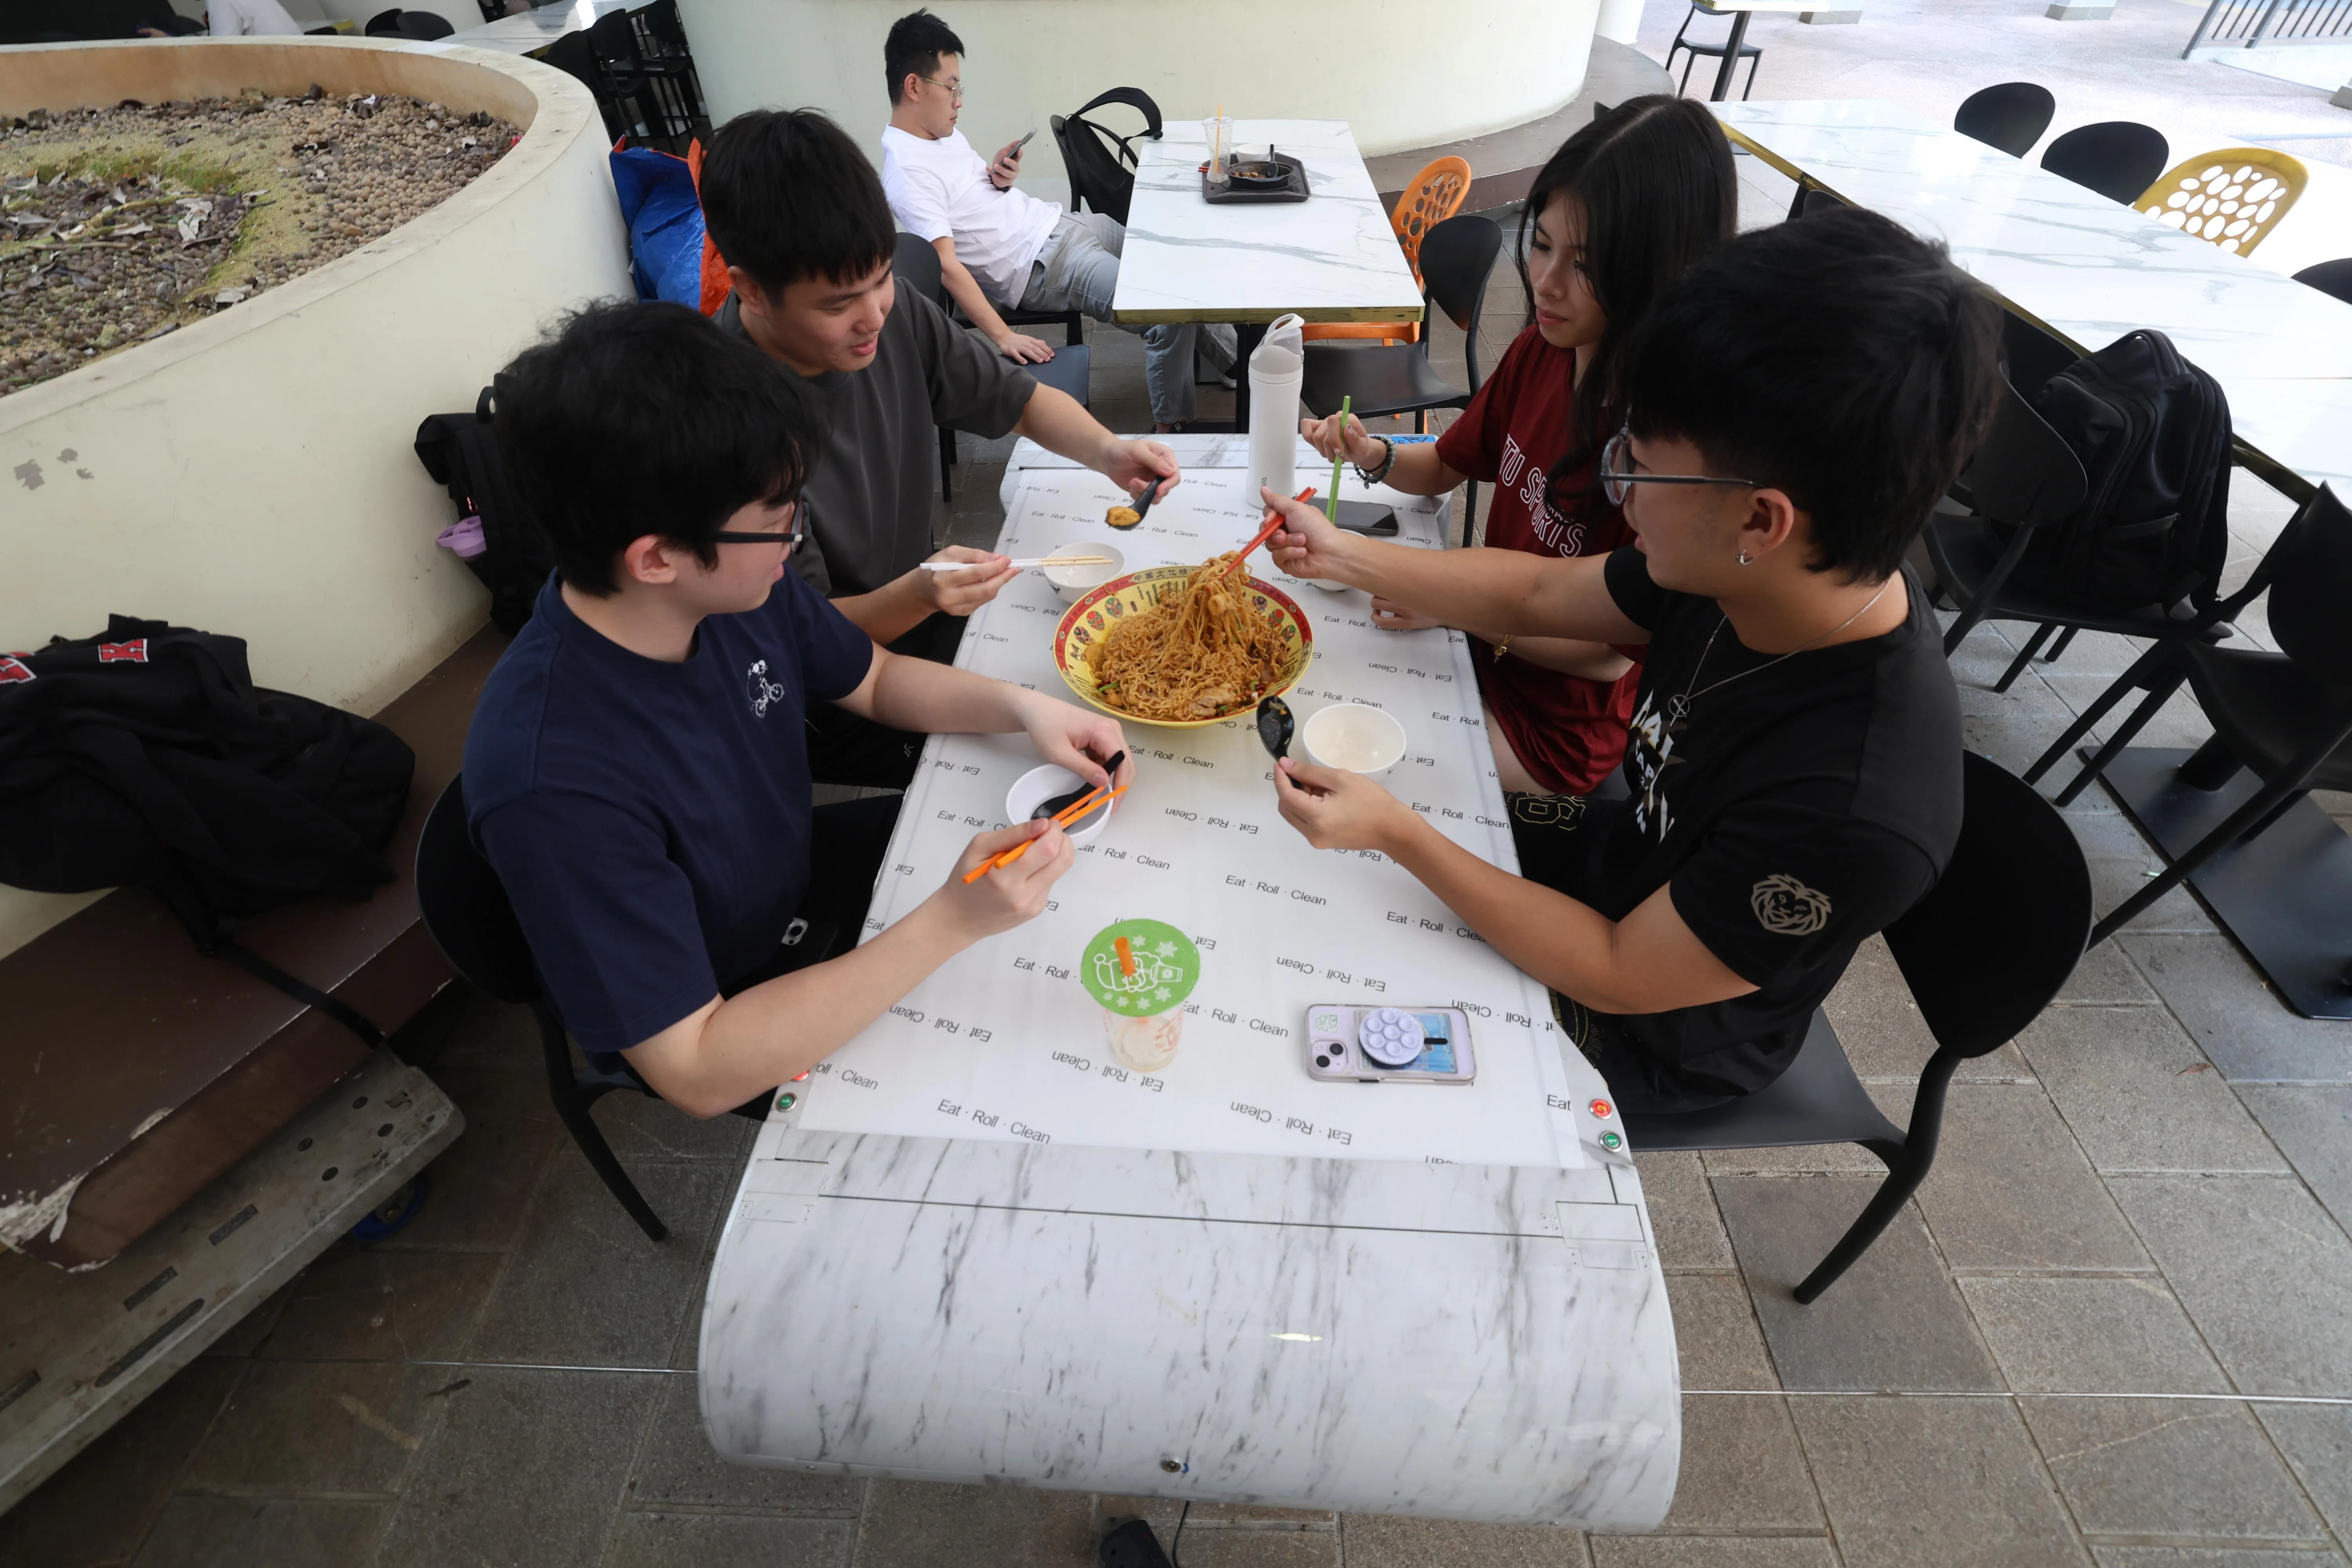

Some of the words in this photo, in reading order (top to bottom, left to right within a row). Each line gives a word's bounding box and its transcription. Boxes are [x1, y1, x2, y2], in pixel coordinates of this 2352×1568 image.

[1499, 433, 1526, 486] TU
[984, 634, 1008, 642] Clean
[1369, 663, 1397, 673] Clean
[1407, 668, 1425, 677] Roll
[1297, 688, 1314, 696] Eat
[1323, 692, 1342, 701] Roll
[1352, 698, 1382, 708] Clean
[1432, 712, 1450, 721] Eat
[1460, 717, 1479, 726] Roll
[1129, 745, 1144, 755] Eat
[1154, 751, 1174, 760] Roll
[1183, 757, 1213, 768] Clean
[1416, 757, 1434, 766] Eat
[935, 760, 955, 770] Roll
[963, 766, 980, 775] Eat
[937, 811, 956, 821] Eat
[964, 817, 985, 827] Roll
[1165, 808, 1197, 821] Clean
[1207, 817, 1229, 828] Roll
[1412, 802, 1431, 813] Eat
[1442, 808, 1463, 820] Roll
[1475, 816, 1509, 829] Clean
[1240, 823, 1258, 834] Eat
[1105, 848, 1127, 859] Roll
[1137, 855, 1170, 869] Clean
[1359, 850, 1381, 861] Roll
[895, 864, 914, 875] Eat
[1226, 875, 1246, 887] Eat
[1257, 882, 1279, 894] Roll
[1291, 890, 1326, 906] Clean
[866, 918, 885, 931] Eat
[1387, 911, 1408, 924] Eat
[1420, 919, 1443, 932] Roll
[1456, 927, 1486, 942] Clea
[1195, 936, 1216, 950] Eat
[1014, 957, 1035, 971] Eat
[1045, 965, 1069, 980] Roll
[1277, 957, 1314, 974] Clean
[1327, 969, 1351, 984] Roll
[1364, 978, 1385, 992] Eat
[889, 1006, 924, 1022] Clean
[1451, 999, 1492, 1018] Clean
[934, 1018, 960, 1033] Roll
[1184, 1001, 1199, 1014] at
[1212, 1009, 1237, 1024] Roll
[1250, 1019, 1288, 1037] Clean
[1506, 1012, 1531, 1028] Roll
[969, 1027, 992, 1042] Eat
[1052, 1051, 1090, 1071] Clean
[816, 1063, 832, 1074] oll
[842, 1070, 878, 1090] Clean
[1102, 1066, 1128, 1082] Roll
[1141, 1076, 1163, 1092] Eat
[1547, 1094, 1571, 1111] Eat
[1231, 1102, 1272, 1122] Clean
[938, 1099, 961, 1116] Eat
[972, 1110, 999, 1127] Roll
[1011, 1122, 1050, 1144] Clean
[1286, 1117, 1313, 1135] Roll
[1328, 1128, 1352, 1145] Eat
